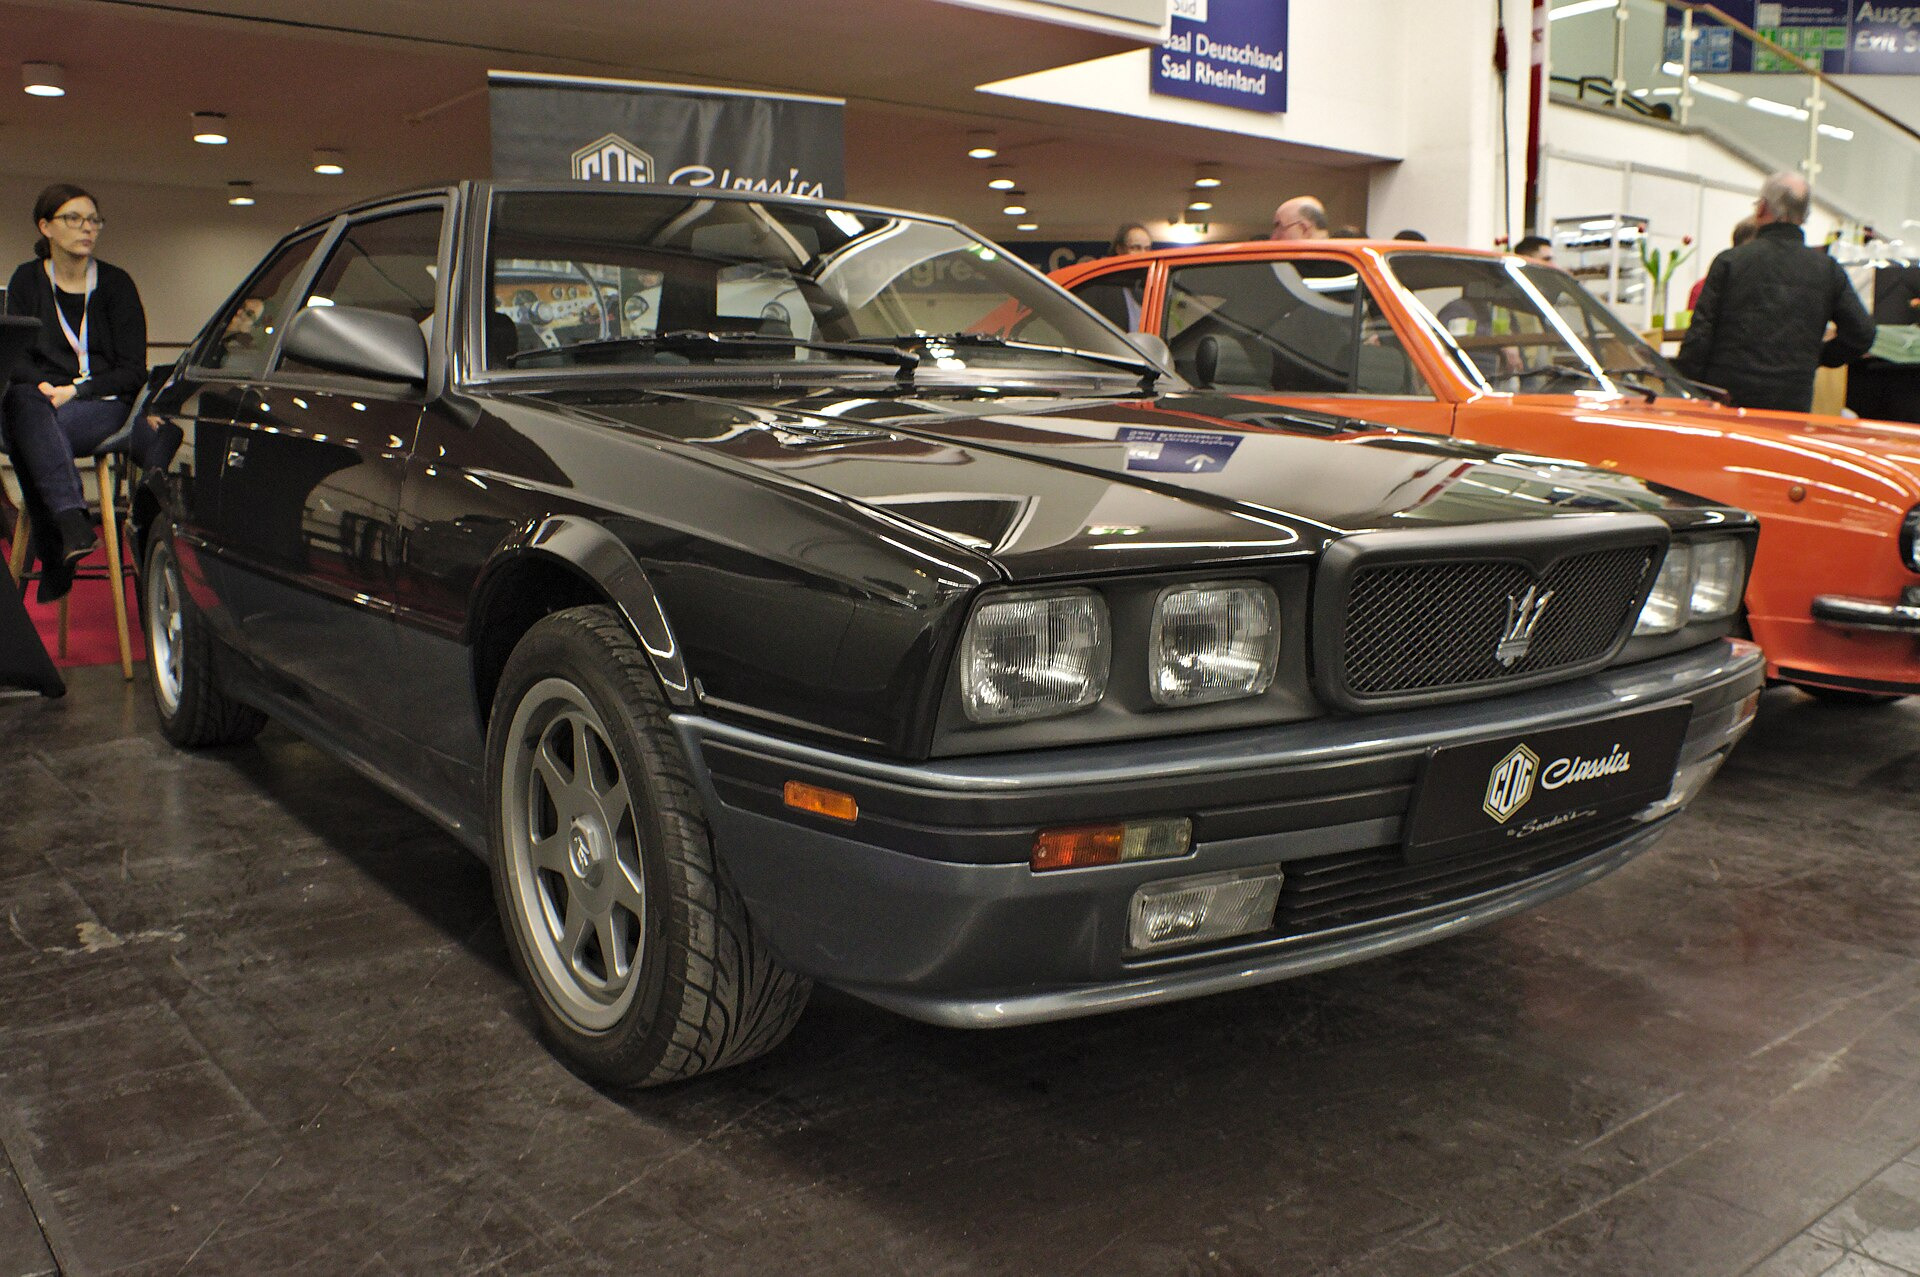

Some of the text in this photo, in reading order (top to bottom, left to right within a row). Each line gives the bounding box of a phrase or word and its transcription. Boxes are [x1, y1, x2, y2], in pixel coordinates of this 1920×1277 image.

[1196, 33, 1284, 72] Deutschland
[1161, 54, 1267, 95] Saal Rheinland
[1541, 743, 1631, 791] Classics
